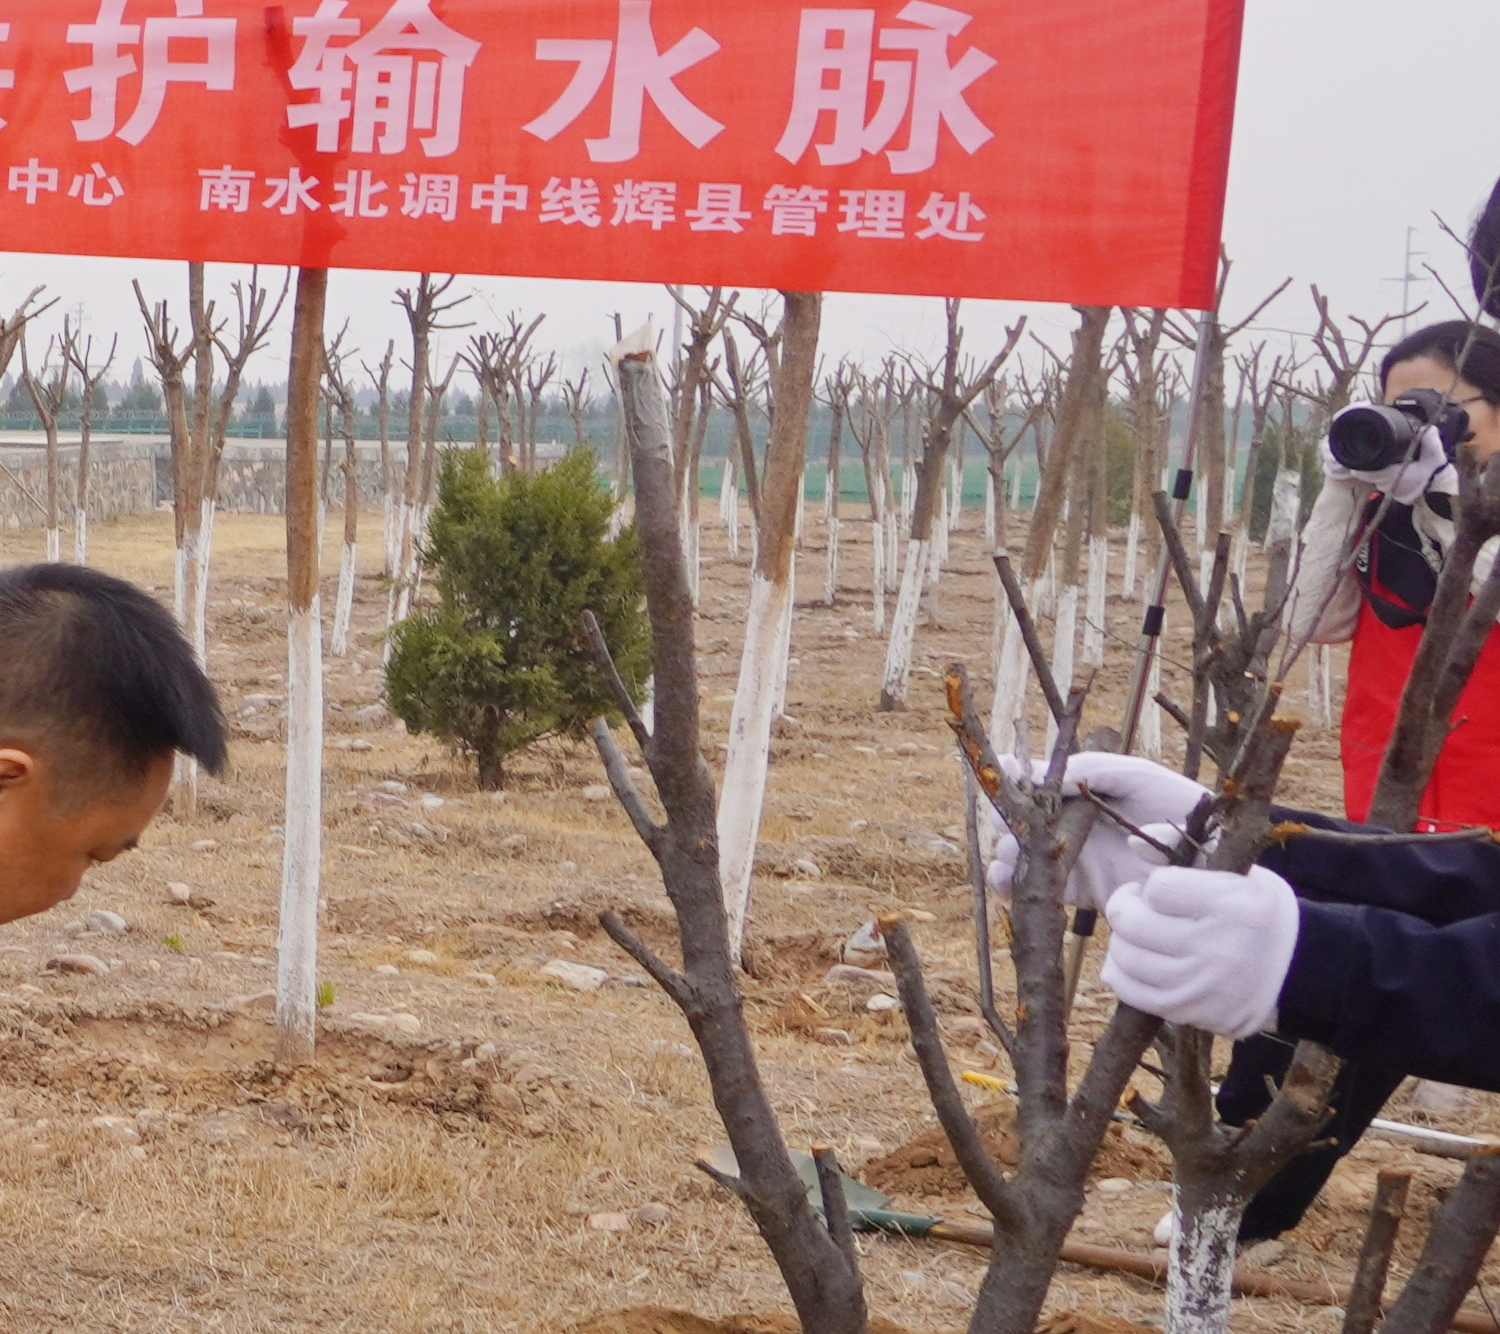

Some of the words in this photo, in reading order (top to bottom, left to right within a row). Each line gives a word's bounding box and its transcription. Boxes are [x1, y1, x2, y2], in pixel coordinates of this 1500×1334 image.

[197, 162, 987, 243] 南水北调中线辉县管理处
